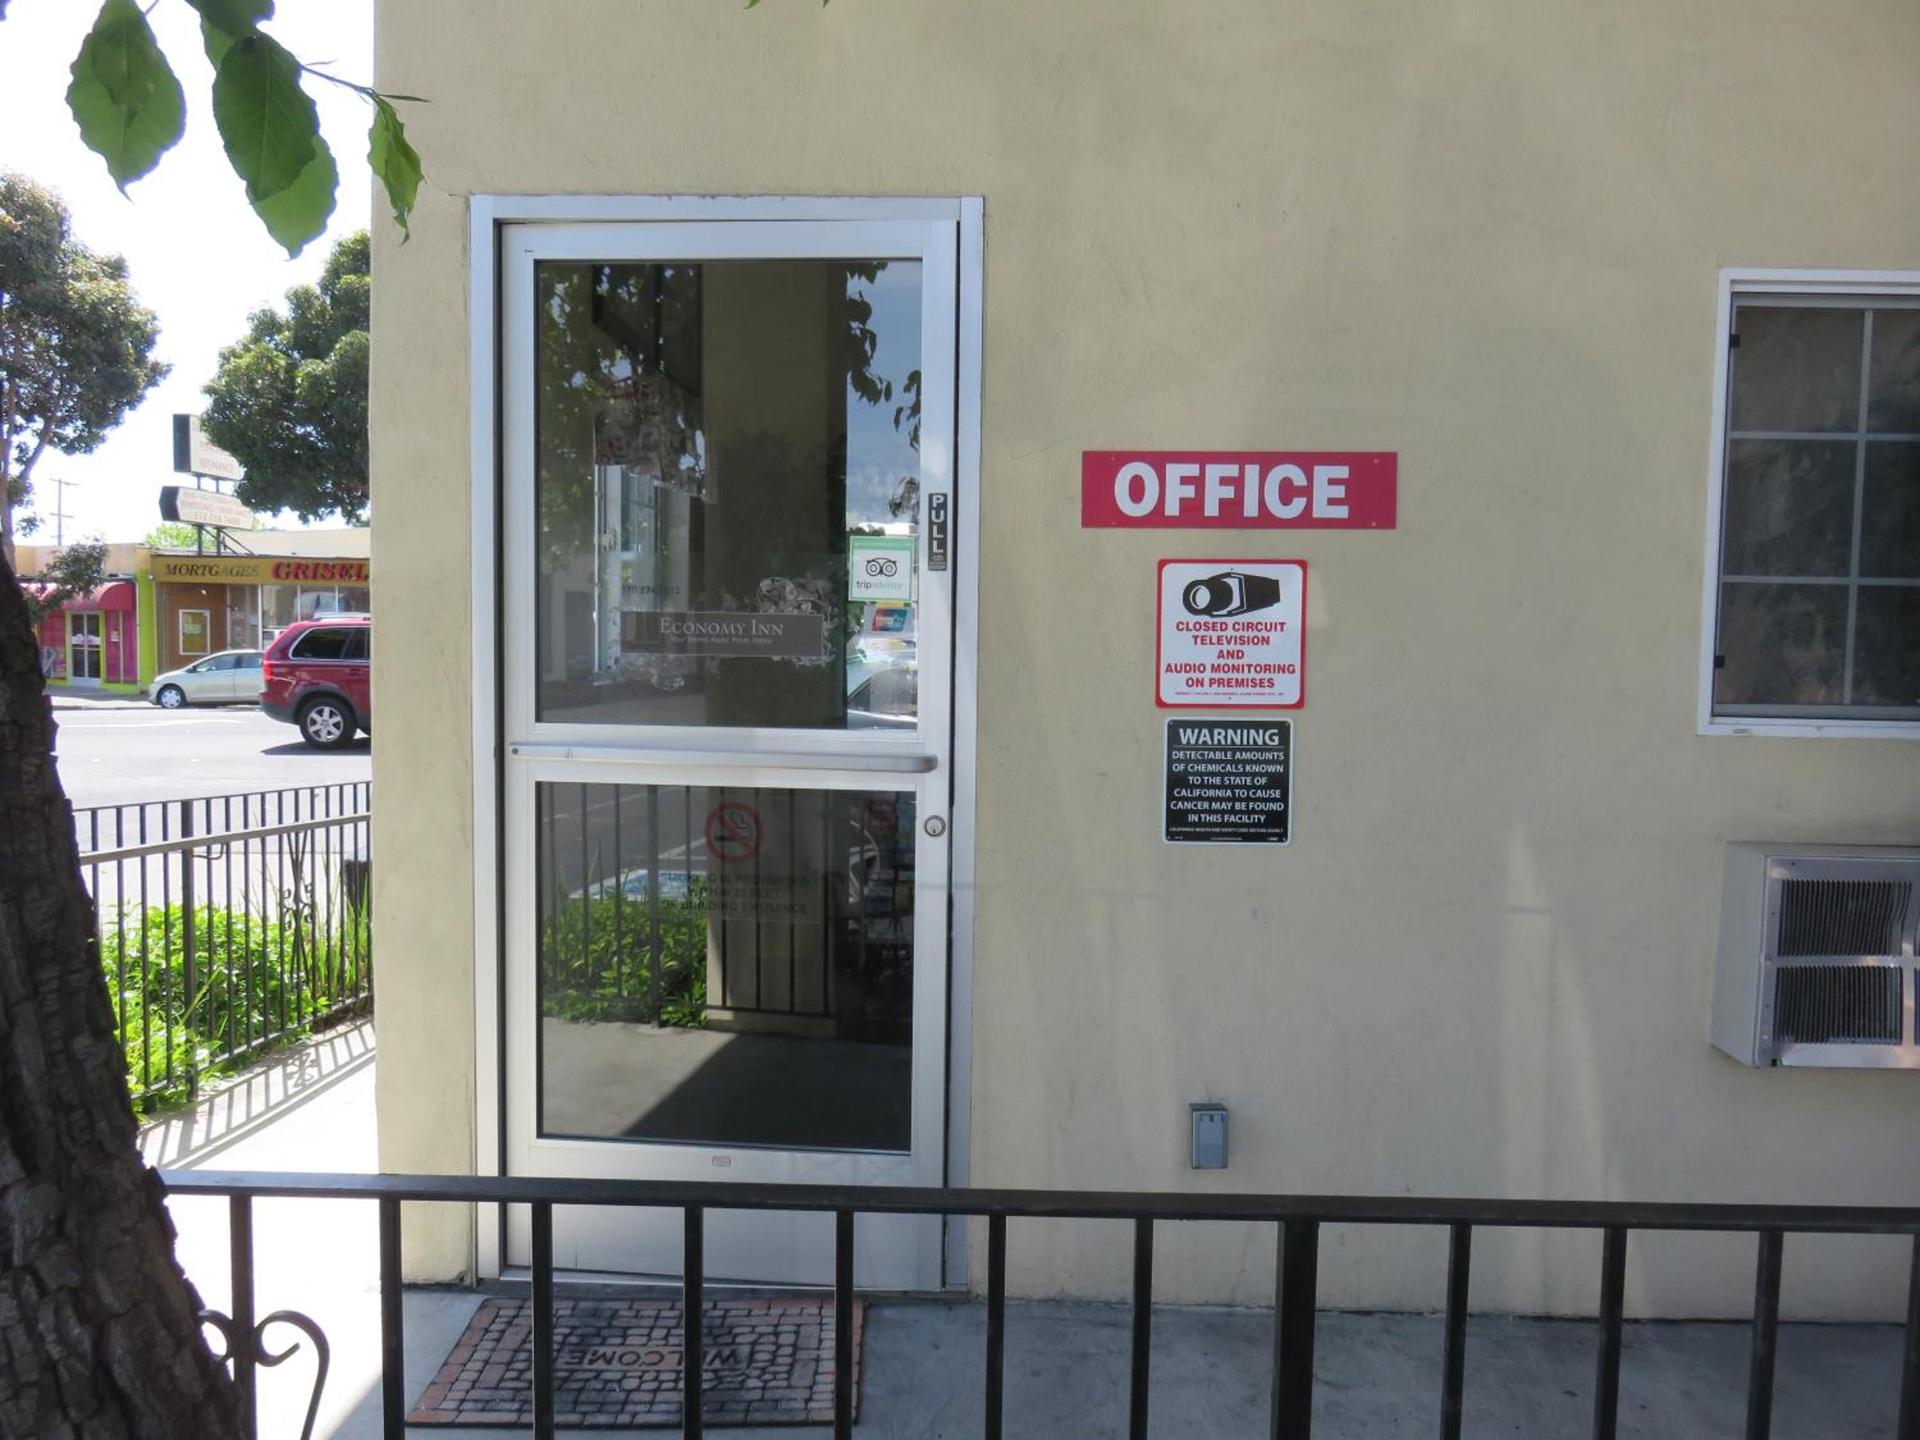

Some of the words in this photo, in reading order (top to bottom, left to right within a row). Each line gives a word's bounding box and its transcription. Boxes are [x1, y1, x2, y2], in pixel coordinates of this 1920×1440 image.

[1114, 461, 1350, 519] OFFICE
[931, 494, 945, 553] PULL
[165, 563, 260, 577] MORTGAGES
[659, 617, 747, 635] ECONOMY
[751, 619, 784, 636] INN
[1176, 621, 1228, 632] CLOSED
[1232, 621, 1287, 632] CIRCUIT
[1192, 635, 1270, 645] TELEVISION
[1217, 649, 1245, 660] AND
[1165, 663, 1206, 674] AUDIO
[1210, 663, 1296, 675] MONITORING
[1185, 677, 1204, 688] ON
[1209, 678, 1275, 688] PREMISES
[1179, 728, 1279, 746] WARNING
[1172, 751, 1232, 760] DETECTABLE
[1234, 751, 1284, 760] AMOUNTS
[1172, 763, 1185, 772] OF
[1188, 763, 1243, 772] CHEMICALS
[1245, 764, 1284, 773] KNOWN
[1188, 776, 1201, 785] TO
[1203, 776, 1221, 785] THE
[1223, 776, 1252, 785] STATE
[1254, 777, 1268, 786] OF
[1174, 788, 1232, 798] CALIFORNIA
[1234, 789, 1247, 798] TO
[1249, 789, 1281, 798] CAUSE
[1170, 801, 1210, 810] CANCER
[1211, 801, 1232, 810] MAY
[1235, 802, 1247, 811] BE
[1249, 802, 1285, 811] FOUND
[1188, 814, 1199, 823] IN
[1200, 814, 1222, 823] THIS
[1224, 814, 1266, 823] FACILITY
[562, 1350, 742, 1367] WLCOME
